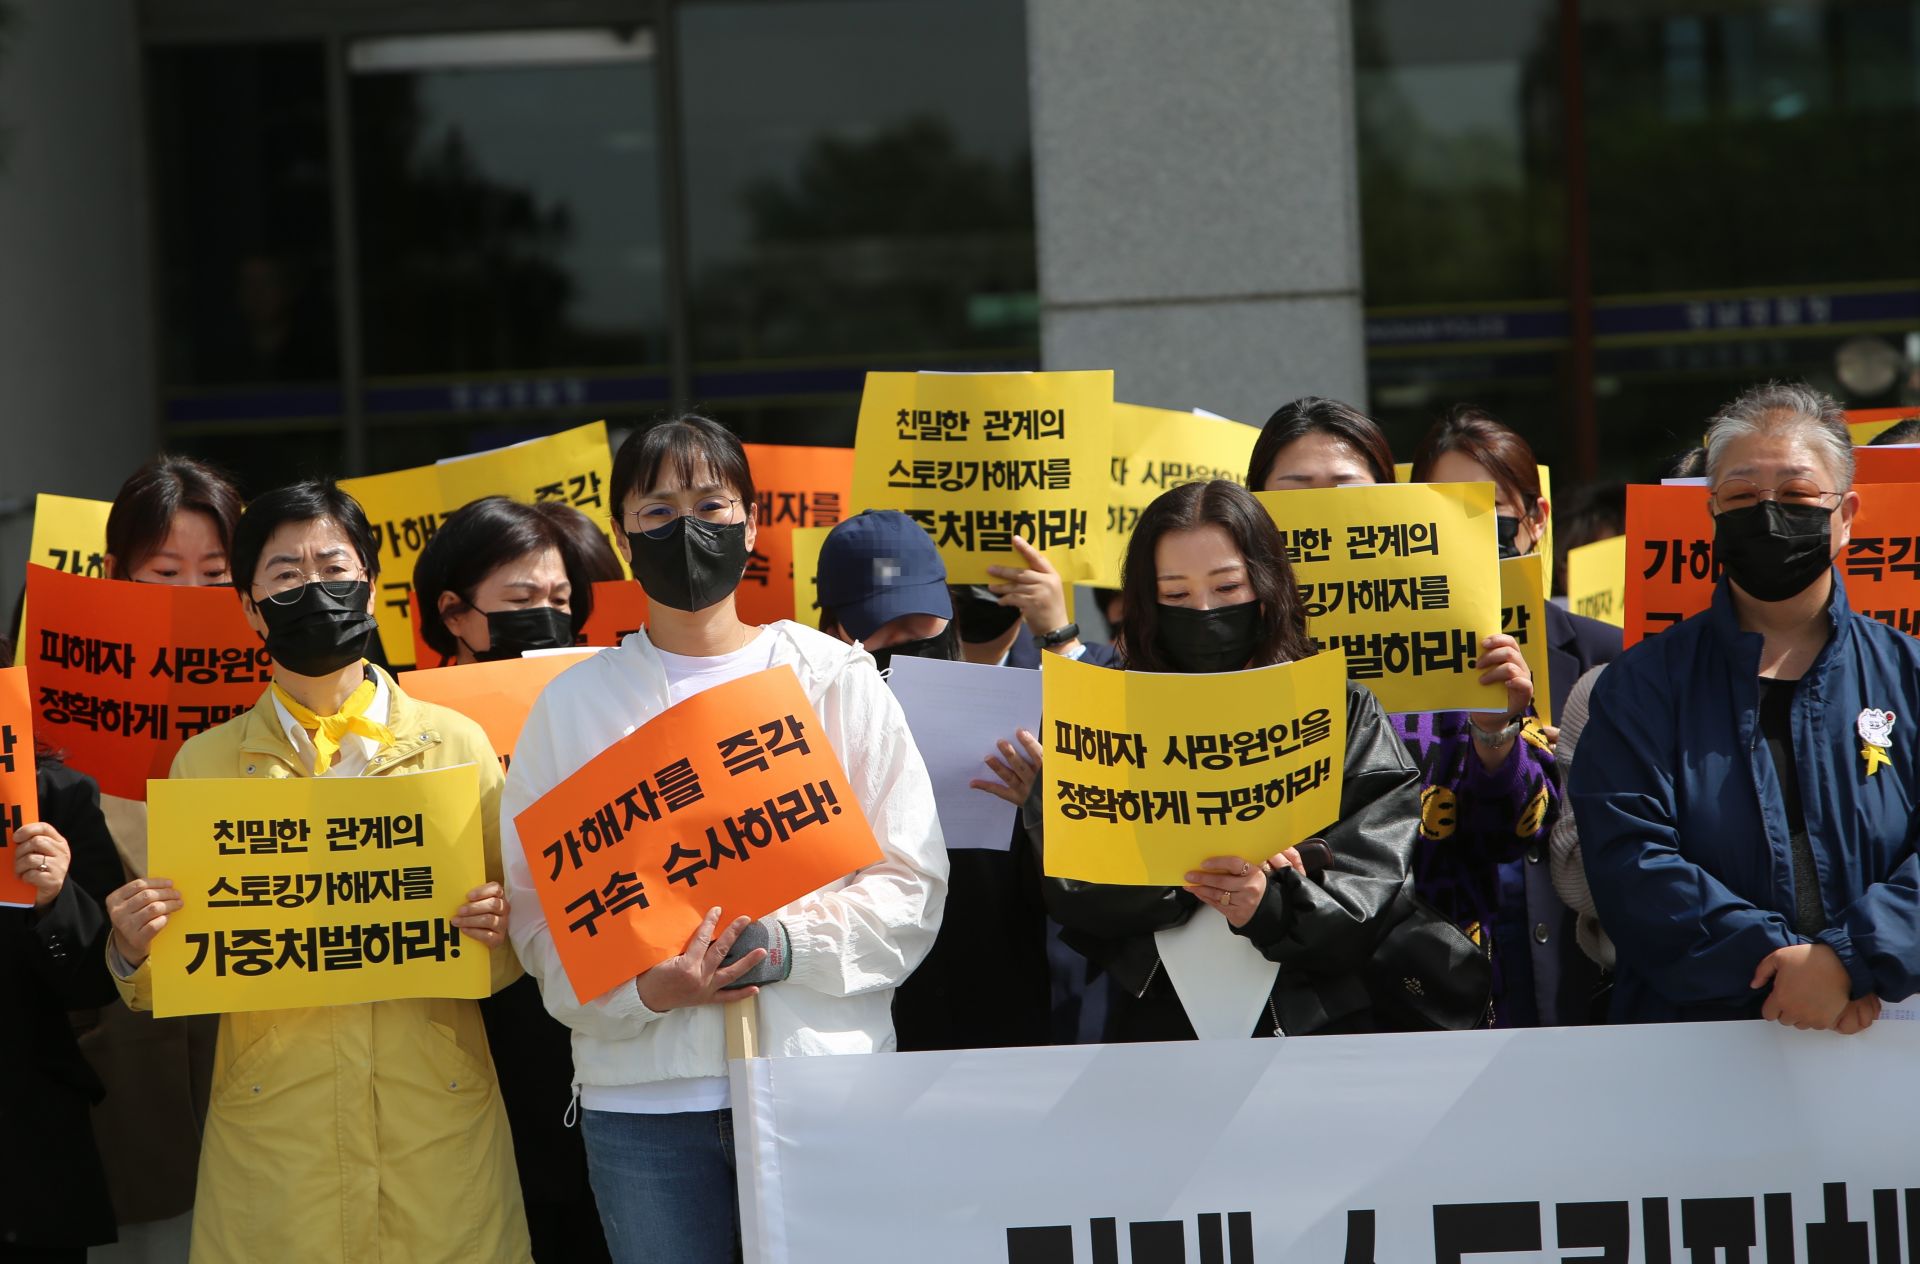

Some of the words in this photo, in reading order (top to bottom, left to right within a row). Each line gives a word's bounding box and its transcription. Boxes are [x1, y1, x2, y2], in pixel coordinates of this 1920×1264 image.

[896, 408, 970, 441] 친밀한
[983, 408, 1064, 441] 관계의
[888, 458, 1071, 492] 스토킹가해자를
[1346, 522, 1439, 560] 관계의
[1300, 575, 1450, 617] 킹가해자를
[40, 629, 136, 679] 피해자
[39, 686, 168, 740] 정확하게
[1055, 719, 1147, 769] 피해자
[1163, 708, 1331, 770] 사망원인을
[542, 757, 705, 881] 가해자를
[716, 714, 811, 776] 즉각
[1057, 780, 1190, 825] 정확하게
[1196, 756, 1331, 825] 규명하라!
[213, 818, 311, 855] 친밀한
[326, 814, 424, 851] 관계의
[564, 870, 650, 937] 구속
[662, 780, 842, 887] 수사하라!
[207, 866, 434, 908] 스토킹가해자를
[185, 918, 460, 977] 가중처벌하라!
